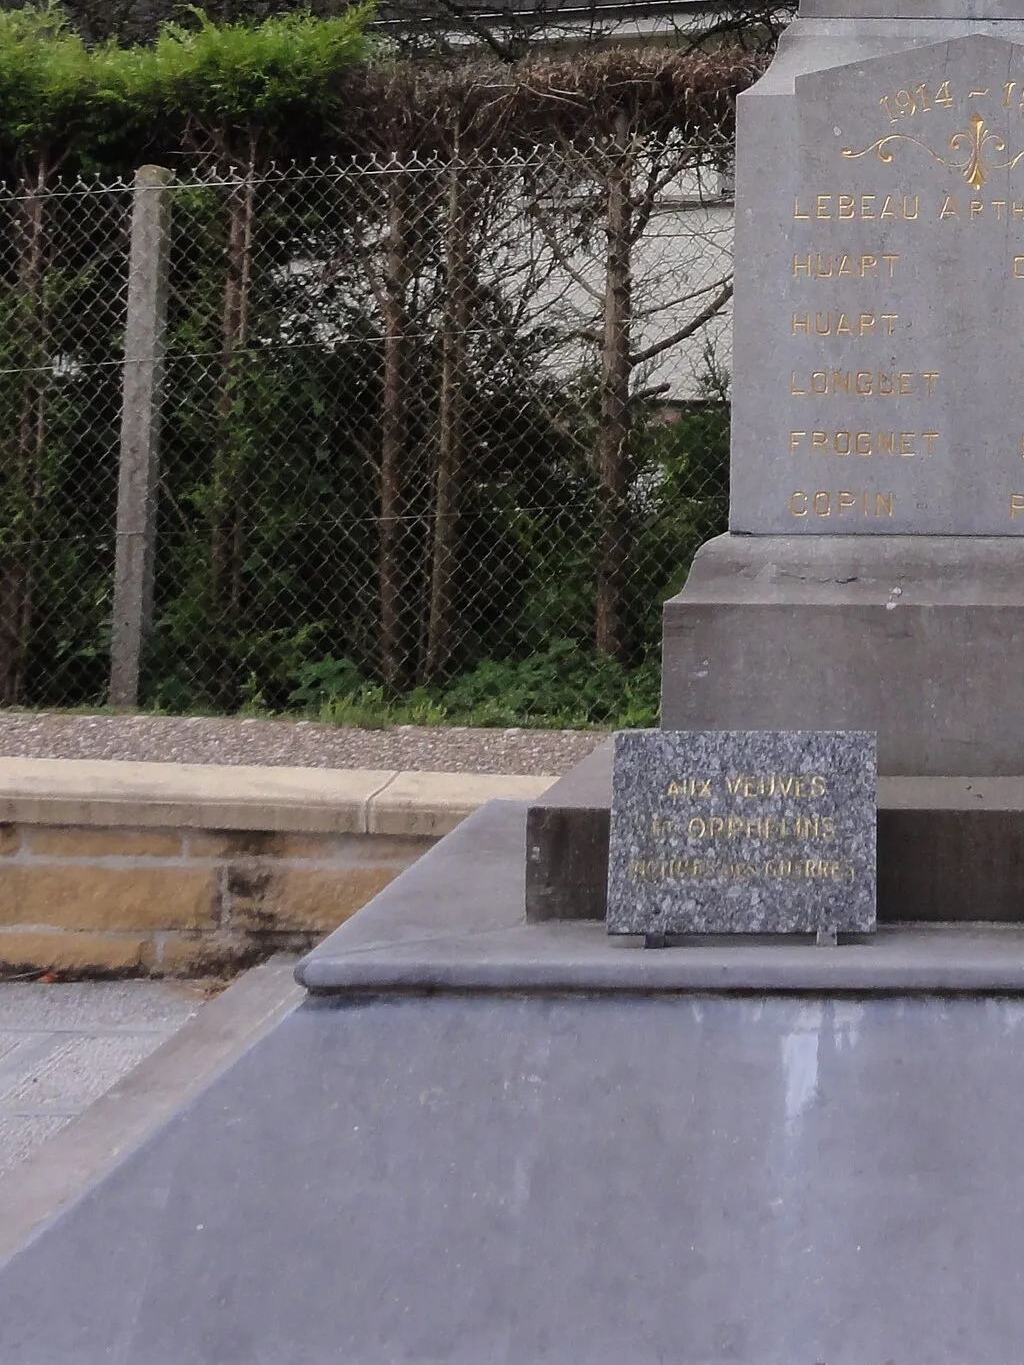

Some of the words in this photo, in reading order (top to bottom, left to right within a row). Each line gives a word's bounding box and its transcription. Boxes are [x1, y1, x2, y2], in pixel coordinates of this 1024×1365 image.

[879, 79, 954, 124] 1914
[793, 194, 920, 221] LEBEAU
[792, 253, 901, 278] HUART
[791, 312, 899, 337] HUART
[790, 370, 940, 396] LONGUET
[788, 430, 940, 457] FROGNET
[788, 490, 894, 518] COPIN
[667, 777, 713, 798] AUX
[725, 774, 827, 798] VEUVES
